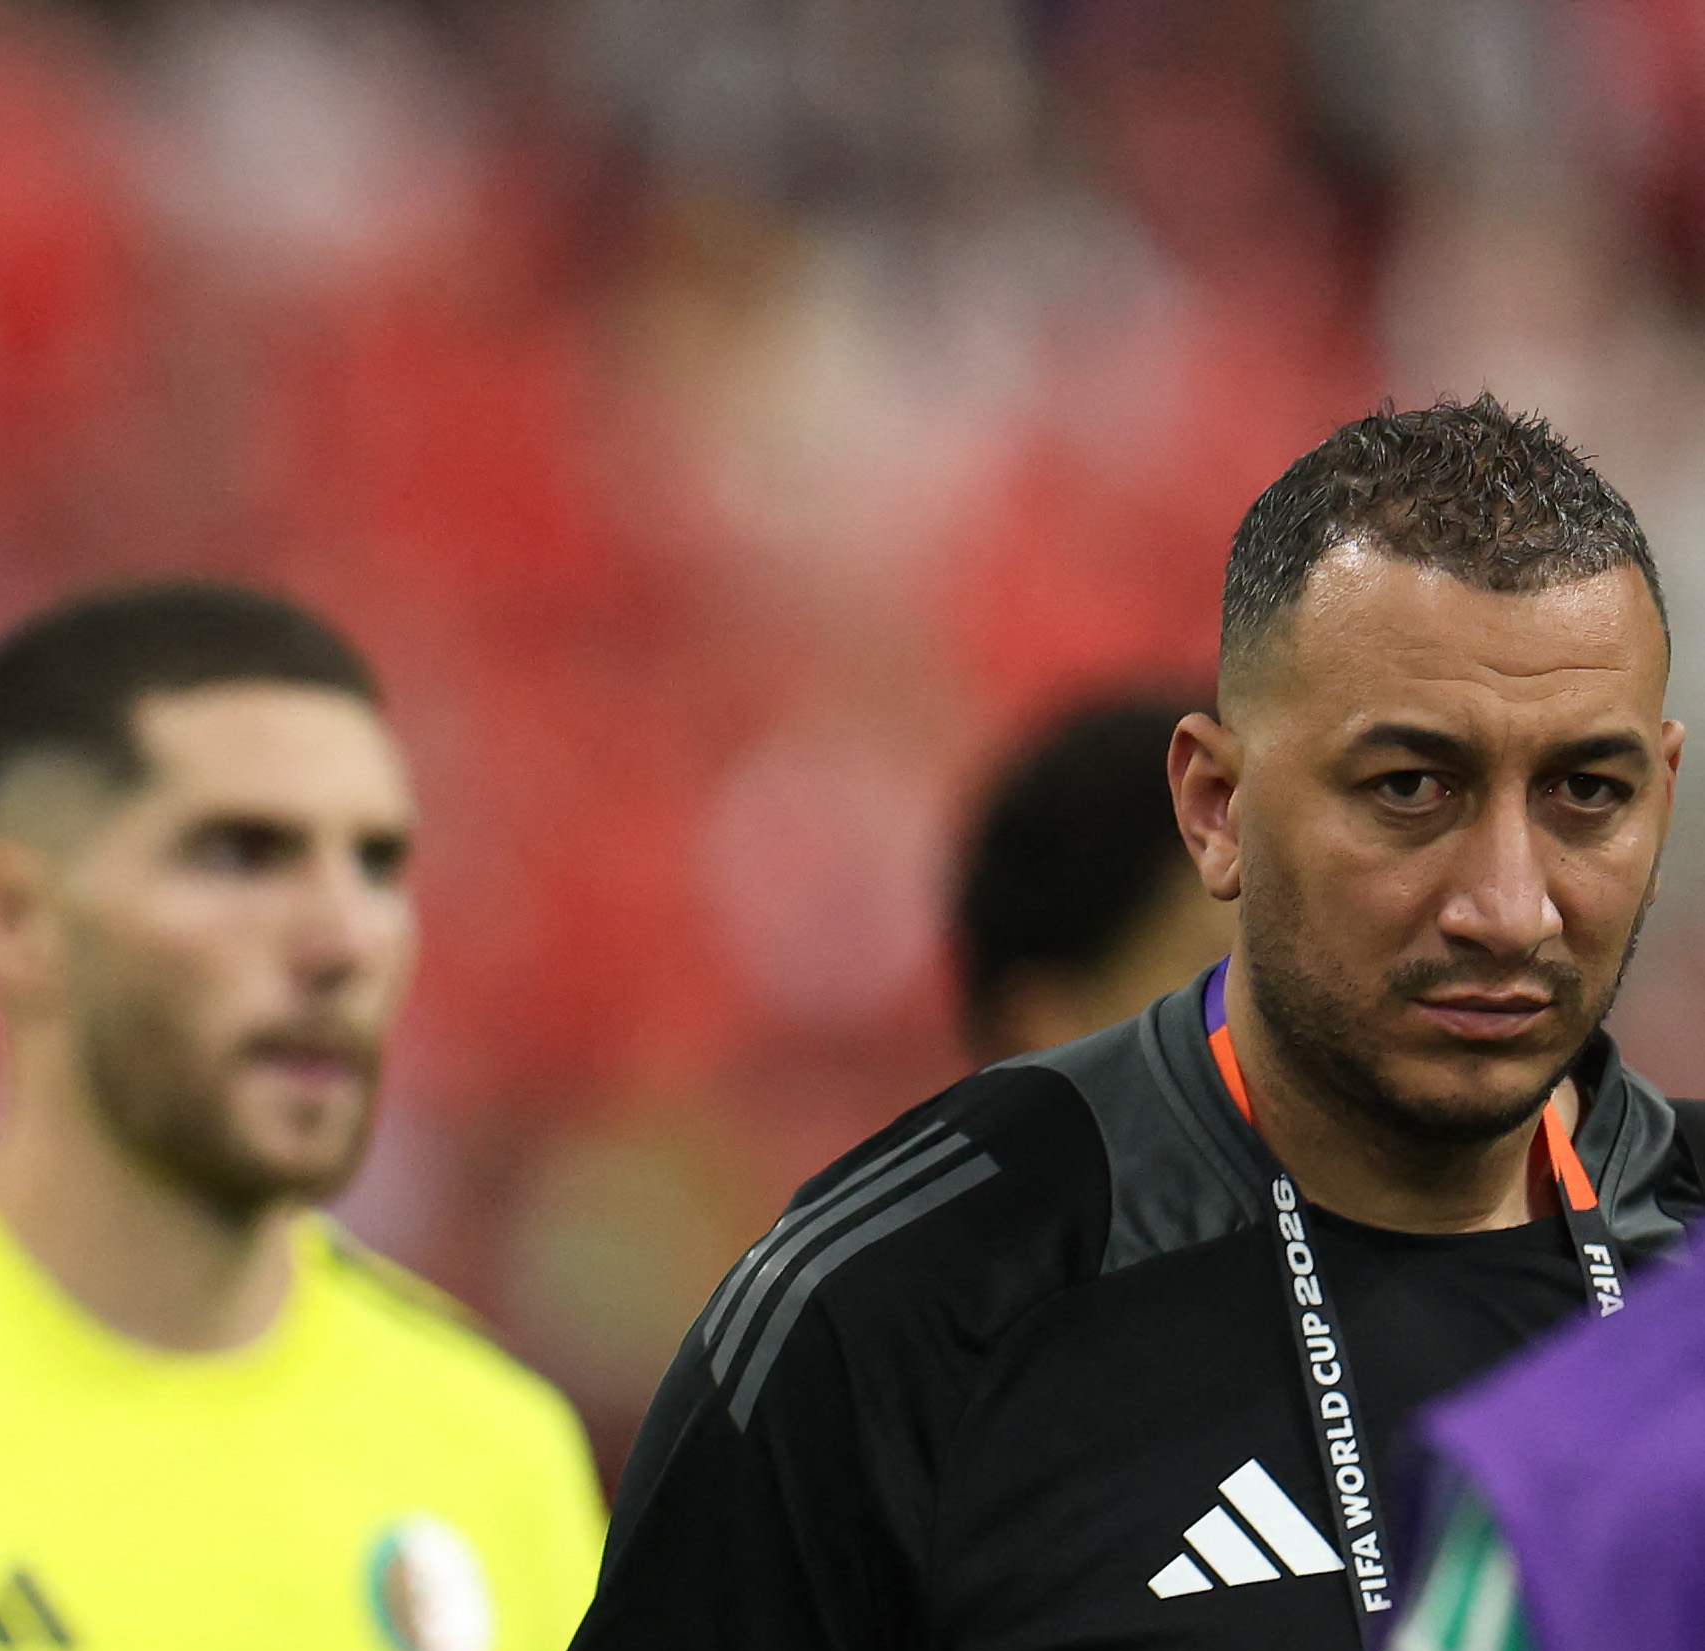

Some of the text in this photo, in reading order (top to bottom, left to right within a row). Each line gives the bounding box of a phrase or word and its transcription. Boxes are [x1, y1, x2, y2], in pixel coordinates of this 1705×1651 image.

[1272, 1178, 1392, 1612] FIFA WORLD CUP 2026
[1583, 1244, 1624, 1318] FIFA
